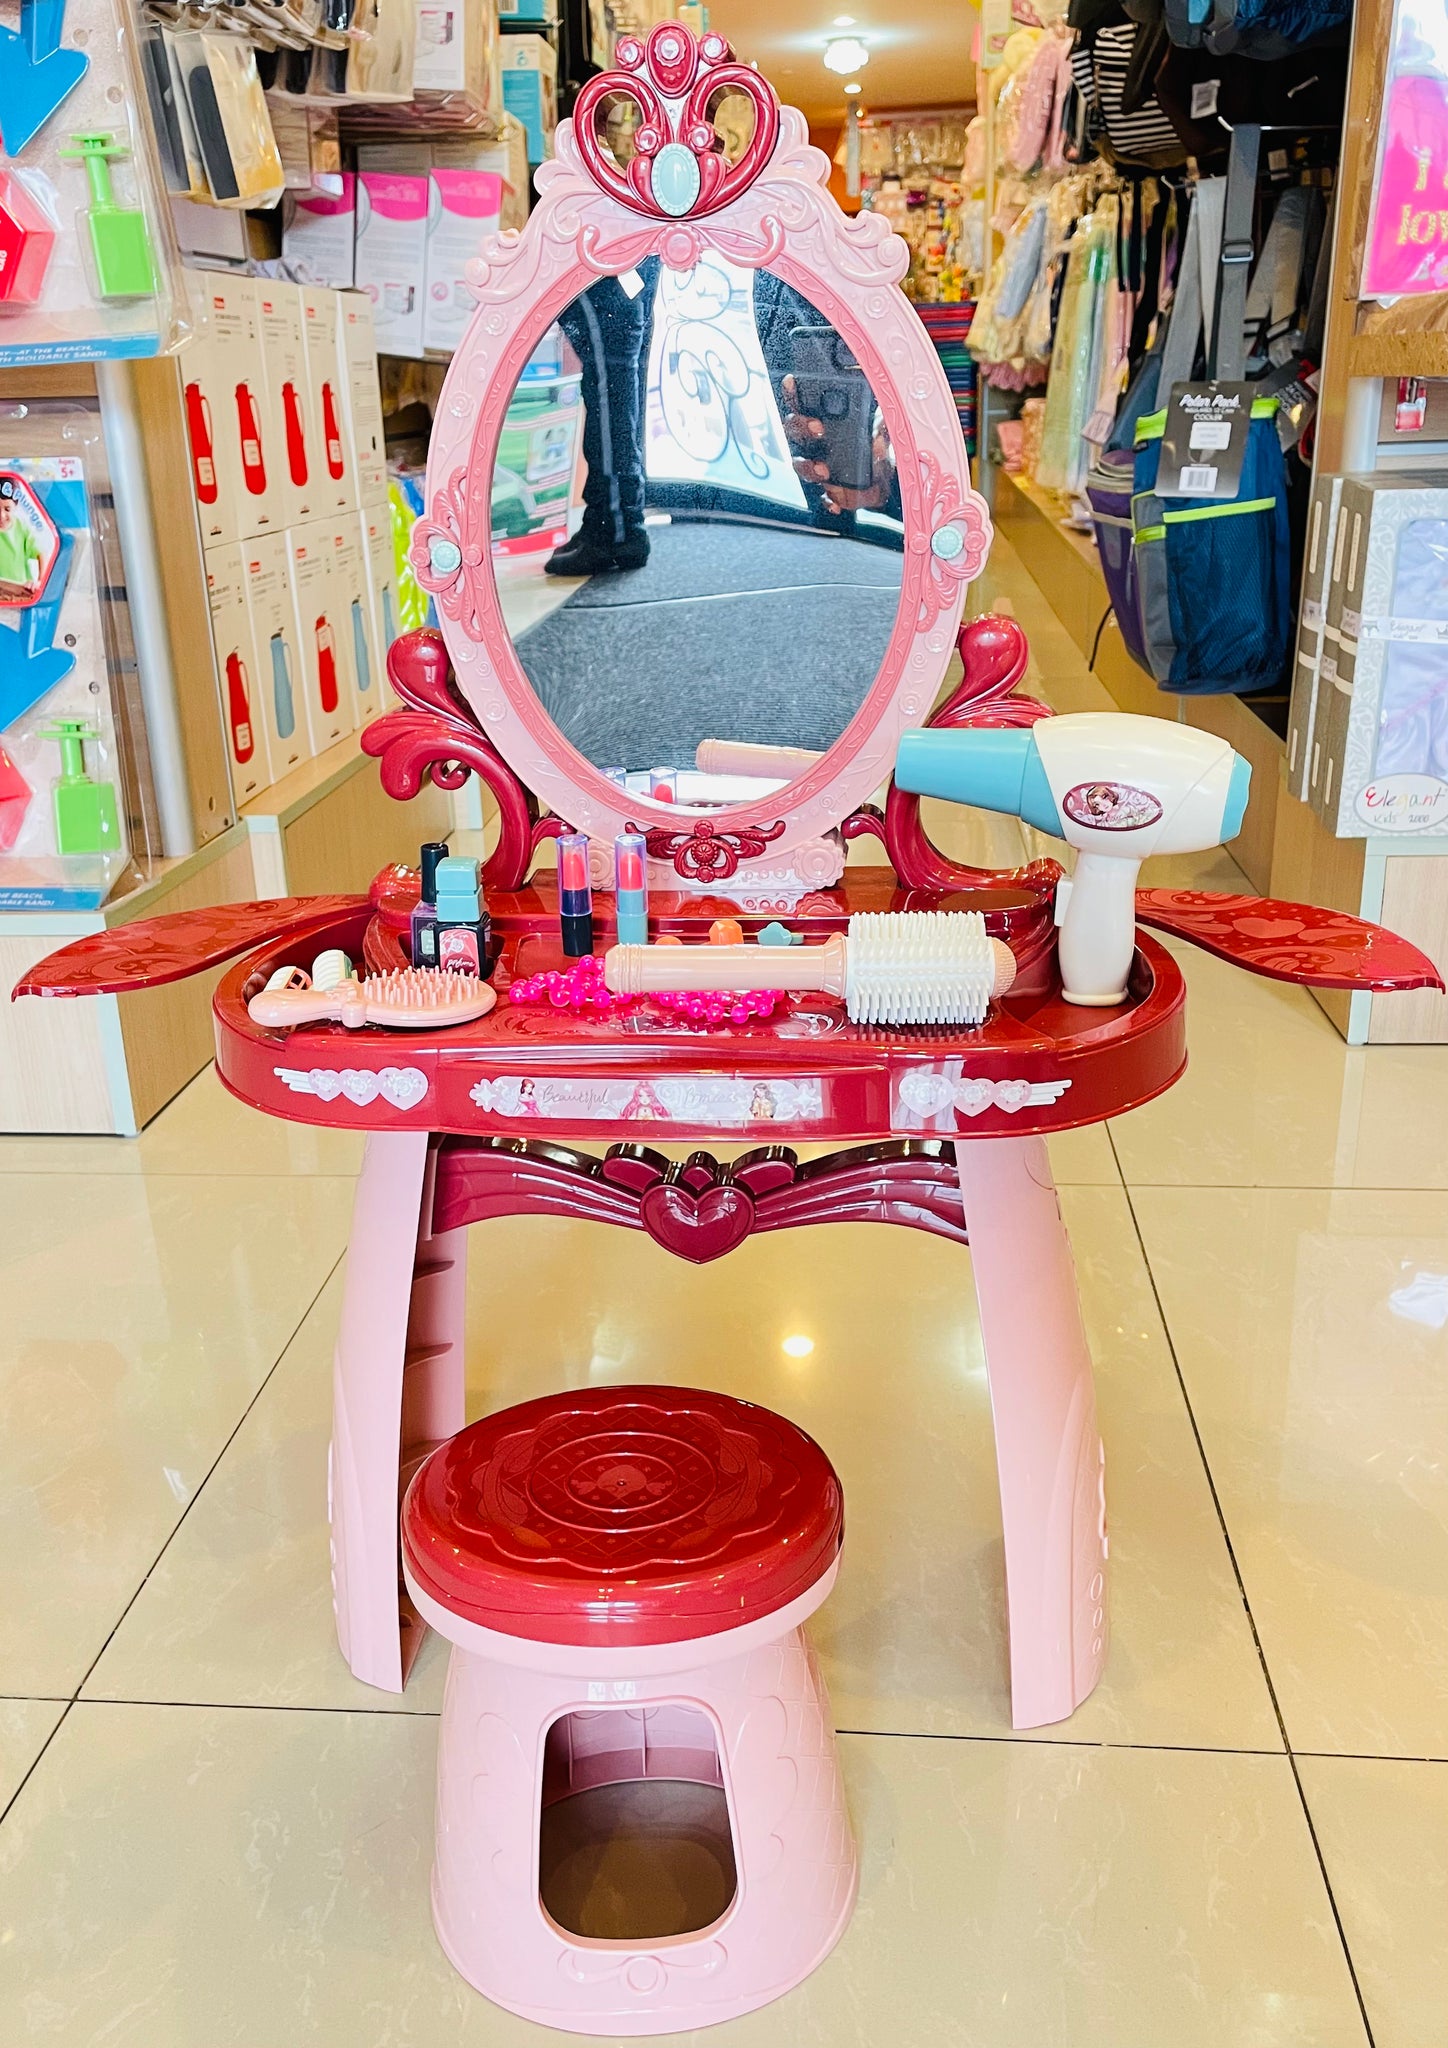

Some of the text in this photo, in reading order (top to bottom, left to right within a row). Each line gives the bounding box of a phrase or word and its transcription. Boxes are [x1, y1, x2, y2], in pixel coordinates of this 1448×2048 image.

[61, 467, 74, 478] 5+
[2, 481, 43, 531] & Plunge
[1365, 786, 1446, 816] Elegant
[446, 957, 476, 969] perfume
[541, 1084, 609, 1110] Beautiful
